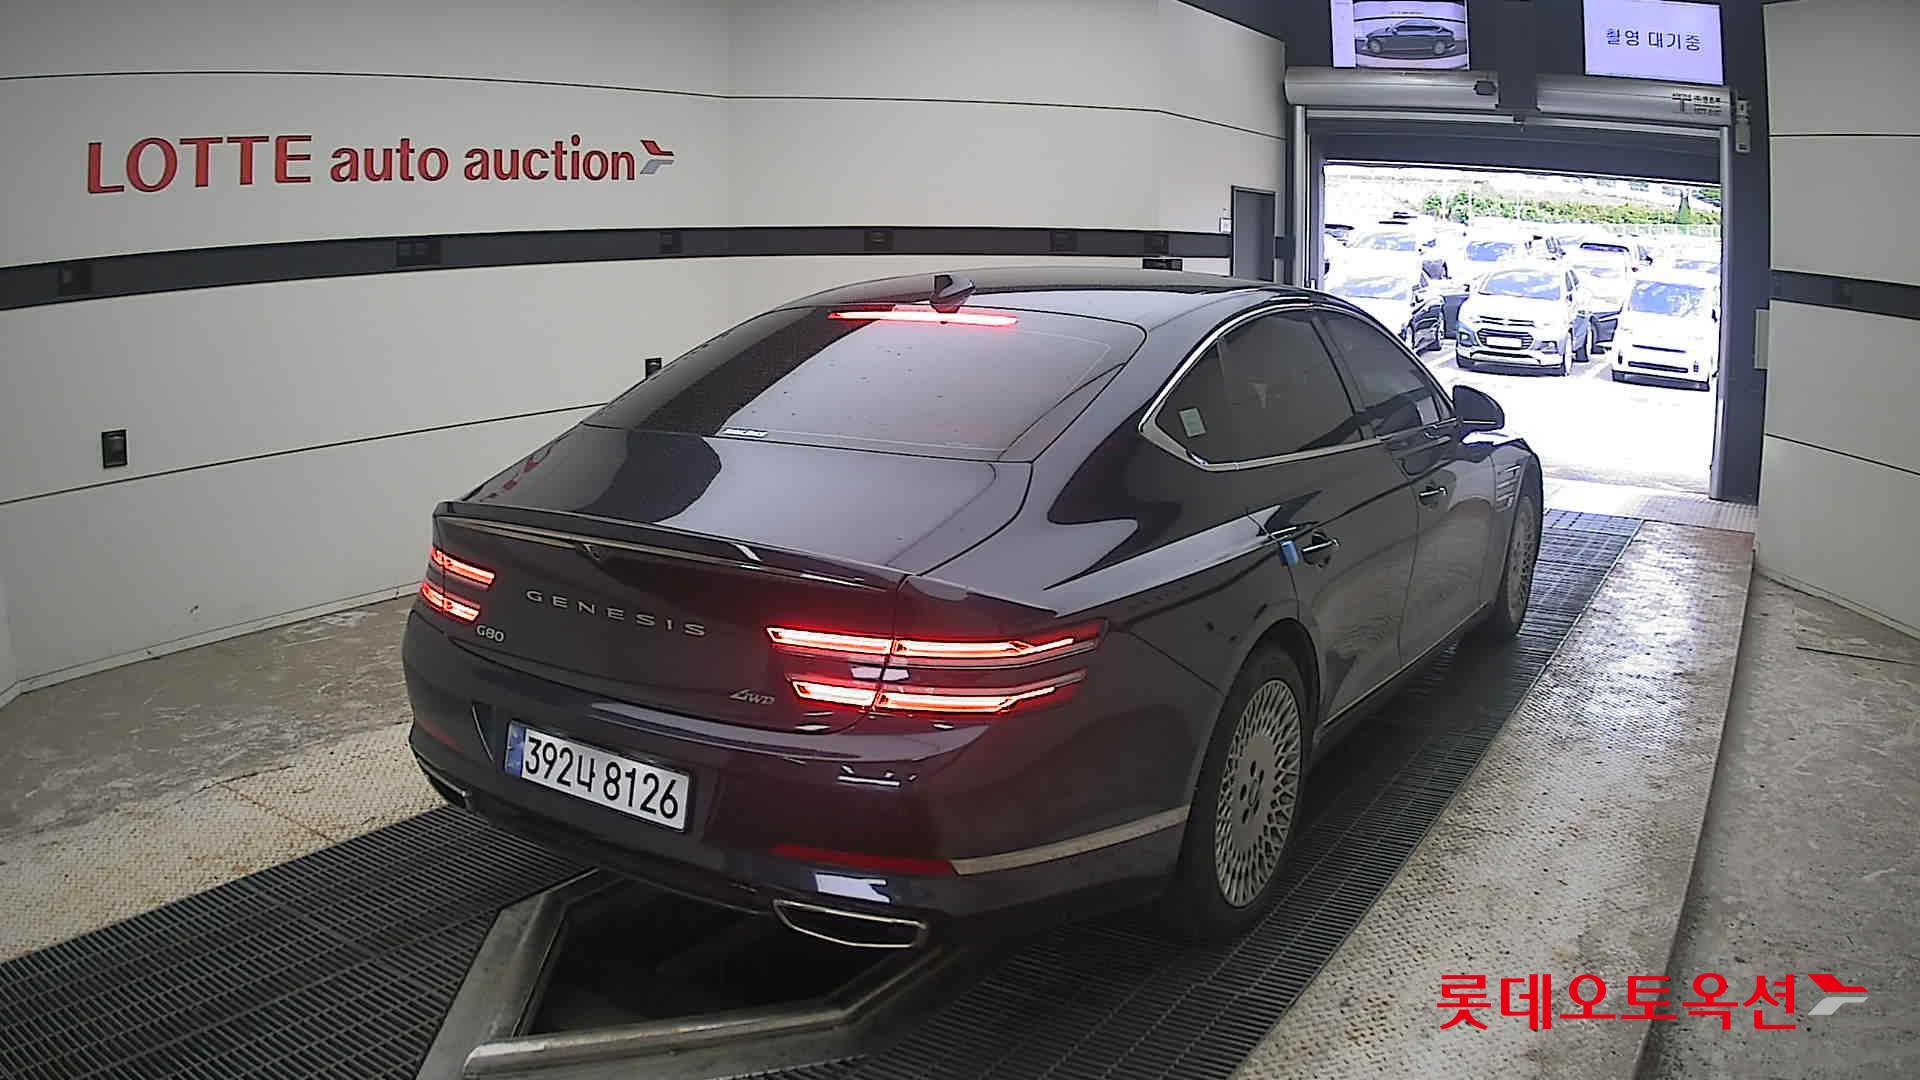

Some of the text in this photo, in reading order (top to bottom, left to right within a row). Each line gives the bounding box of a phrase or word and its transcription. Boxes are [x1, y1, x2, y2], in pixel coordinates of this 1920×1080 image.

[1647, 31, 1700, 51] 대기중
[87, 134, 635, 194] LOTTE auto auction
[476, 623, 505, 643] G80
[526, 589, 706, 637] GENESIS
[525, 736, 679, 820] 392나 8126
